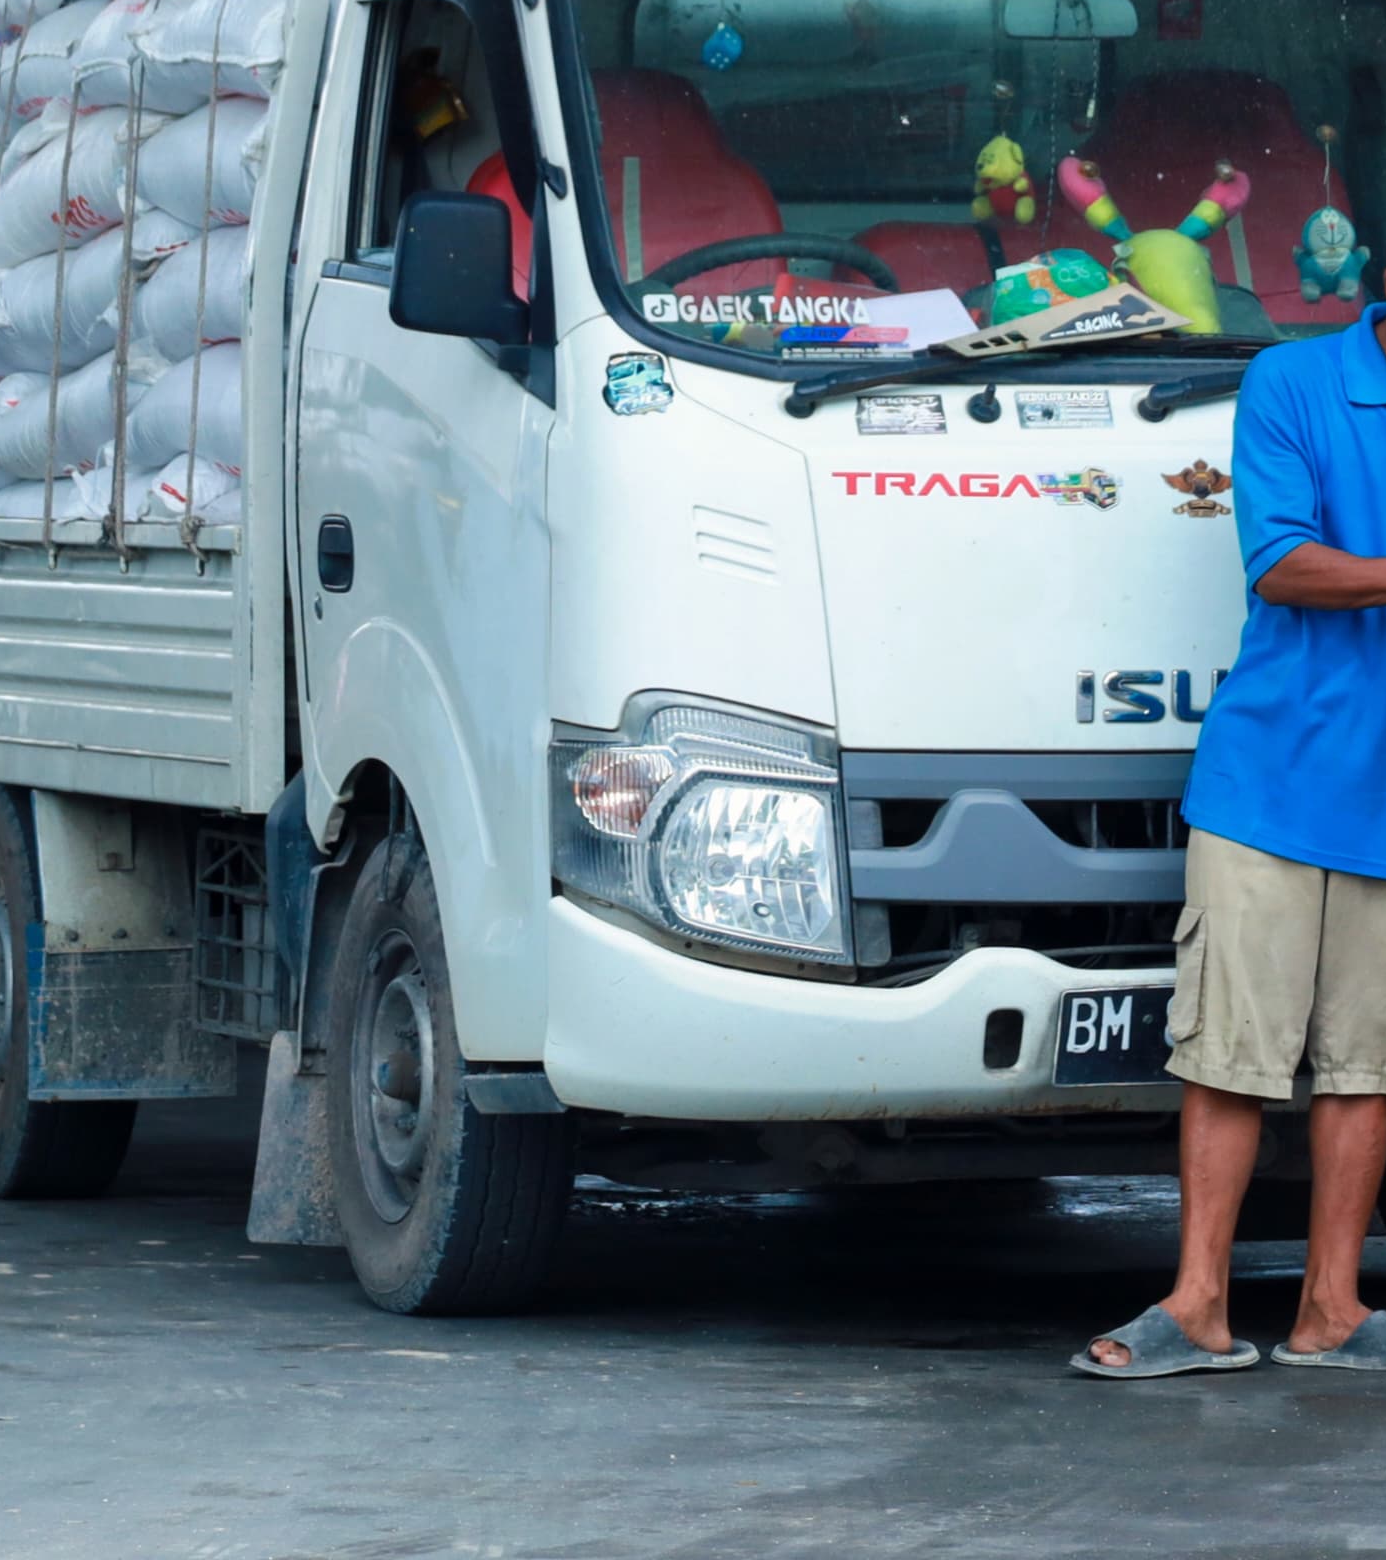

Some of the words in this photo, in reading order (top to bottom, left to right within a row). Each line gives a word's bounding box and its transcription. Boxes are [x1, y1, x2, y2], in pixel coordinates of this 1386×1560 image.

[678, 294, 755, 322] GAEK
[757, 296, 872, 324] TANGKA
[1074, 312, 1123, 334] RACING
[832, 471, 1041, 498] TRAGA
[1066, 995, 1134, 1053] BM
